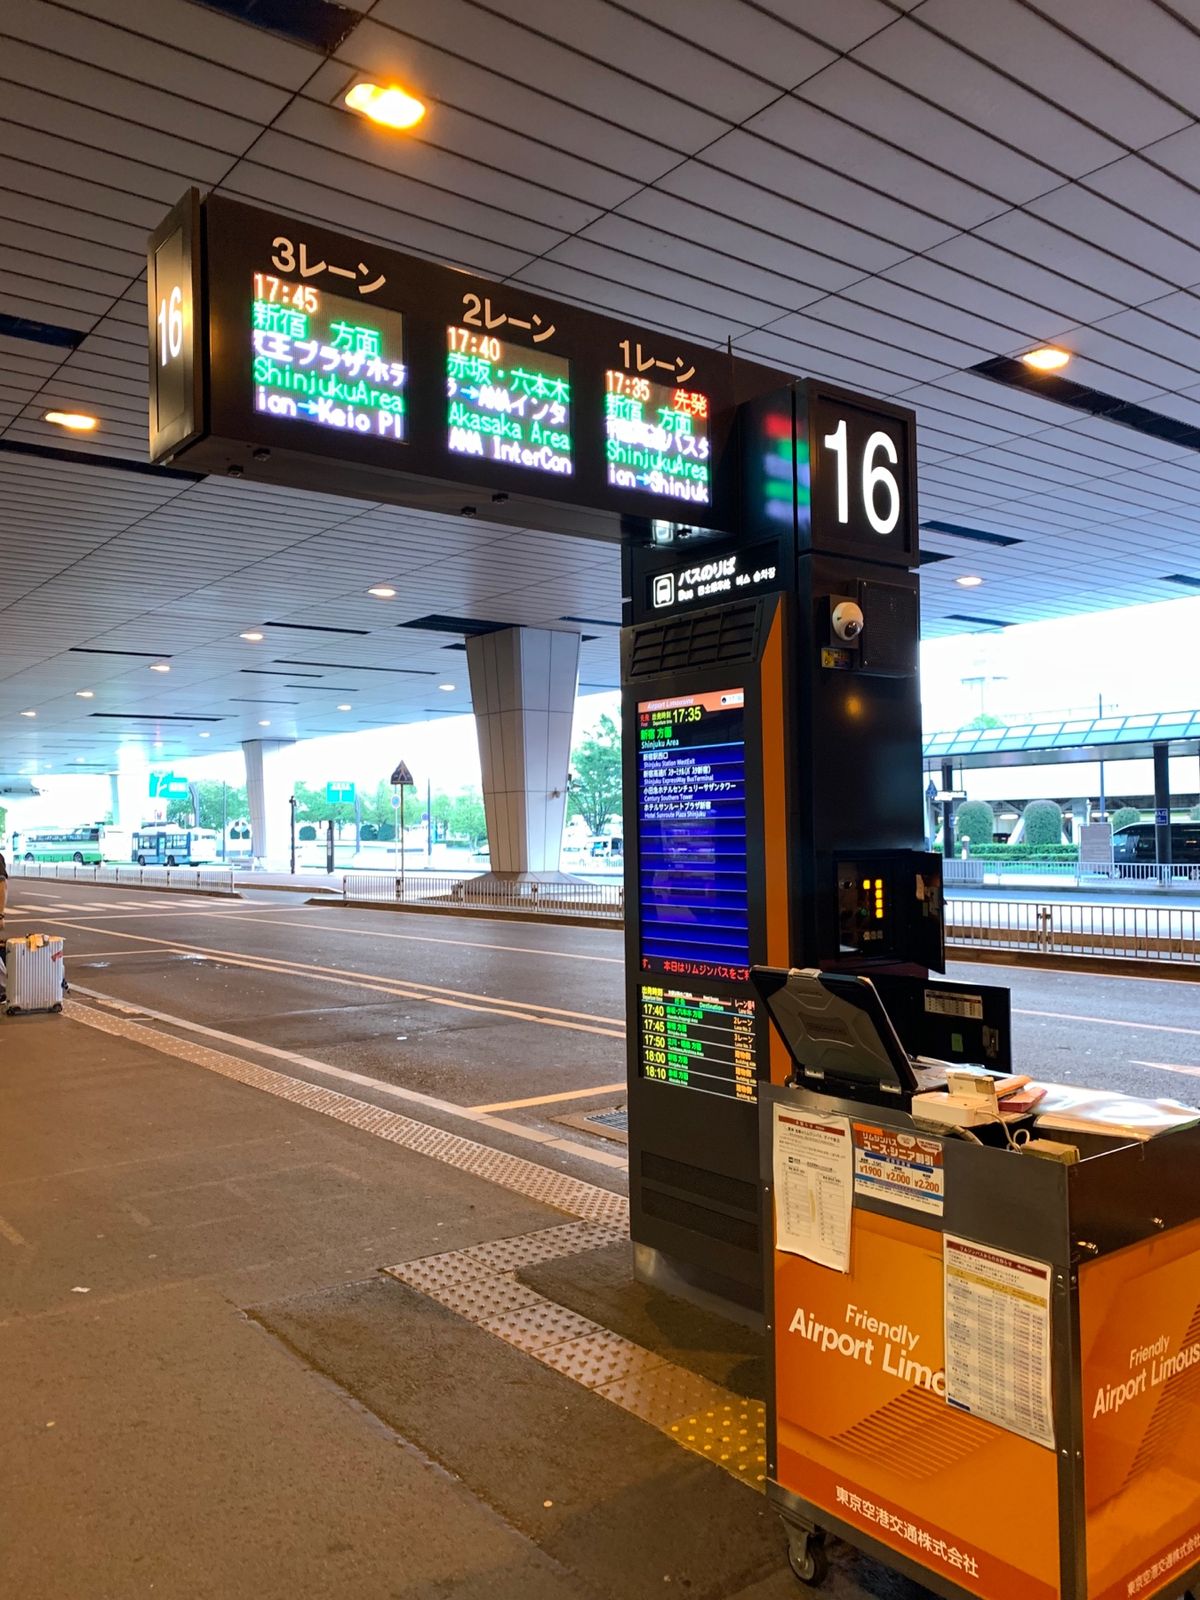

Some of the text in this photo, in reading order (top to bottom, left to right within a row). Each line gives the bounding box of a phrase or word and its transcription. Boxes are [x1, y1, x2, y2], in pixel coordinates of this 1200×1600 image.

[271, 236, 386, 295] 3レーン
[253, 272, 319, 314] 17:45
[157, 286, 183, 367] 16
[253, 302, 380, 358] 新宿 方面
[462, 293, 556, 343] 2レーン
[447, 326, 501, 362] 17:40
[619, 340, 696, 384] 1レーン
[447, 352, 571, 402] 赤坂・六本木
[605, 369, 651, 402] 17:35
[318, 397, 371, 432] Keio
[605, 393, 693, 436] 新宿 方面
[673, 388, 708, 418] 先発
[448, 401, 523, 441] Akasaka
[531, 420, 571, 451] Area
[493, 435, 573, 475] InterCon
[649, 471, 710, 503] Shinjuk
[824, 419, 901, 535] 16
[677, 556, 737, 587] バスのりば
[673, 707, 702, 723] 17:35
[641, 739, 679, 750] Shinjuku Area
[643, 1003, 665, 1017] 17:40
[644, 1018, 665, 1033] 17:45
[645, 1034, 666, 1049] 17:50
[645, 1049, 666, 1064] 18:00
[645, 1065, 667, 1080] 18:10
[845, 1303, 920, 1351] Friendly
[788, 1307, 945, 1397] Airport Limo
[1129, 1334, 1170, 1369] Friendly
[1092, 1342, 1200, 1419] Airport Limous
[835, 1484, 980, 1579] 東京空港交通株式会社
